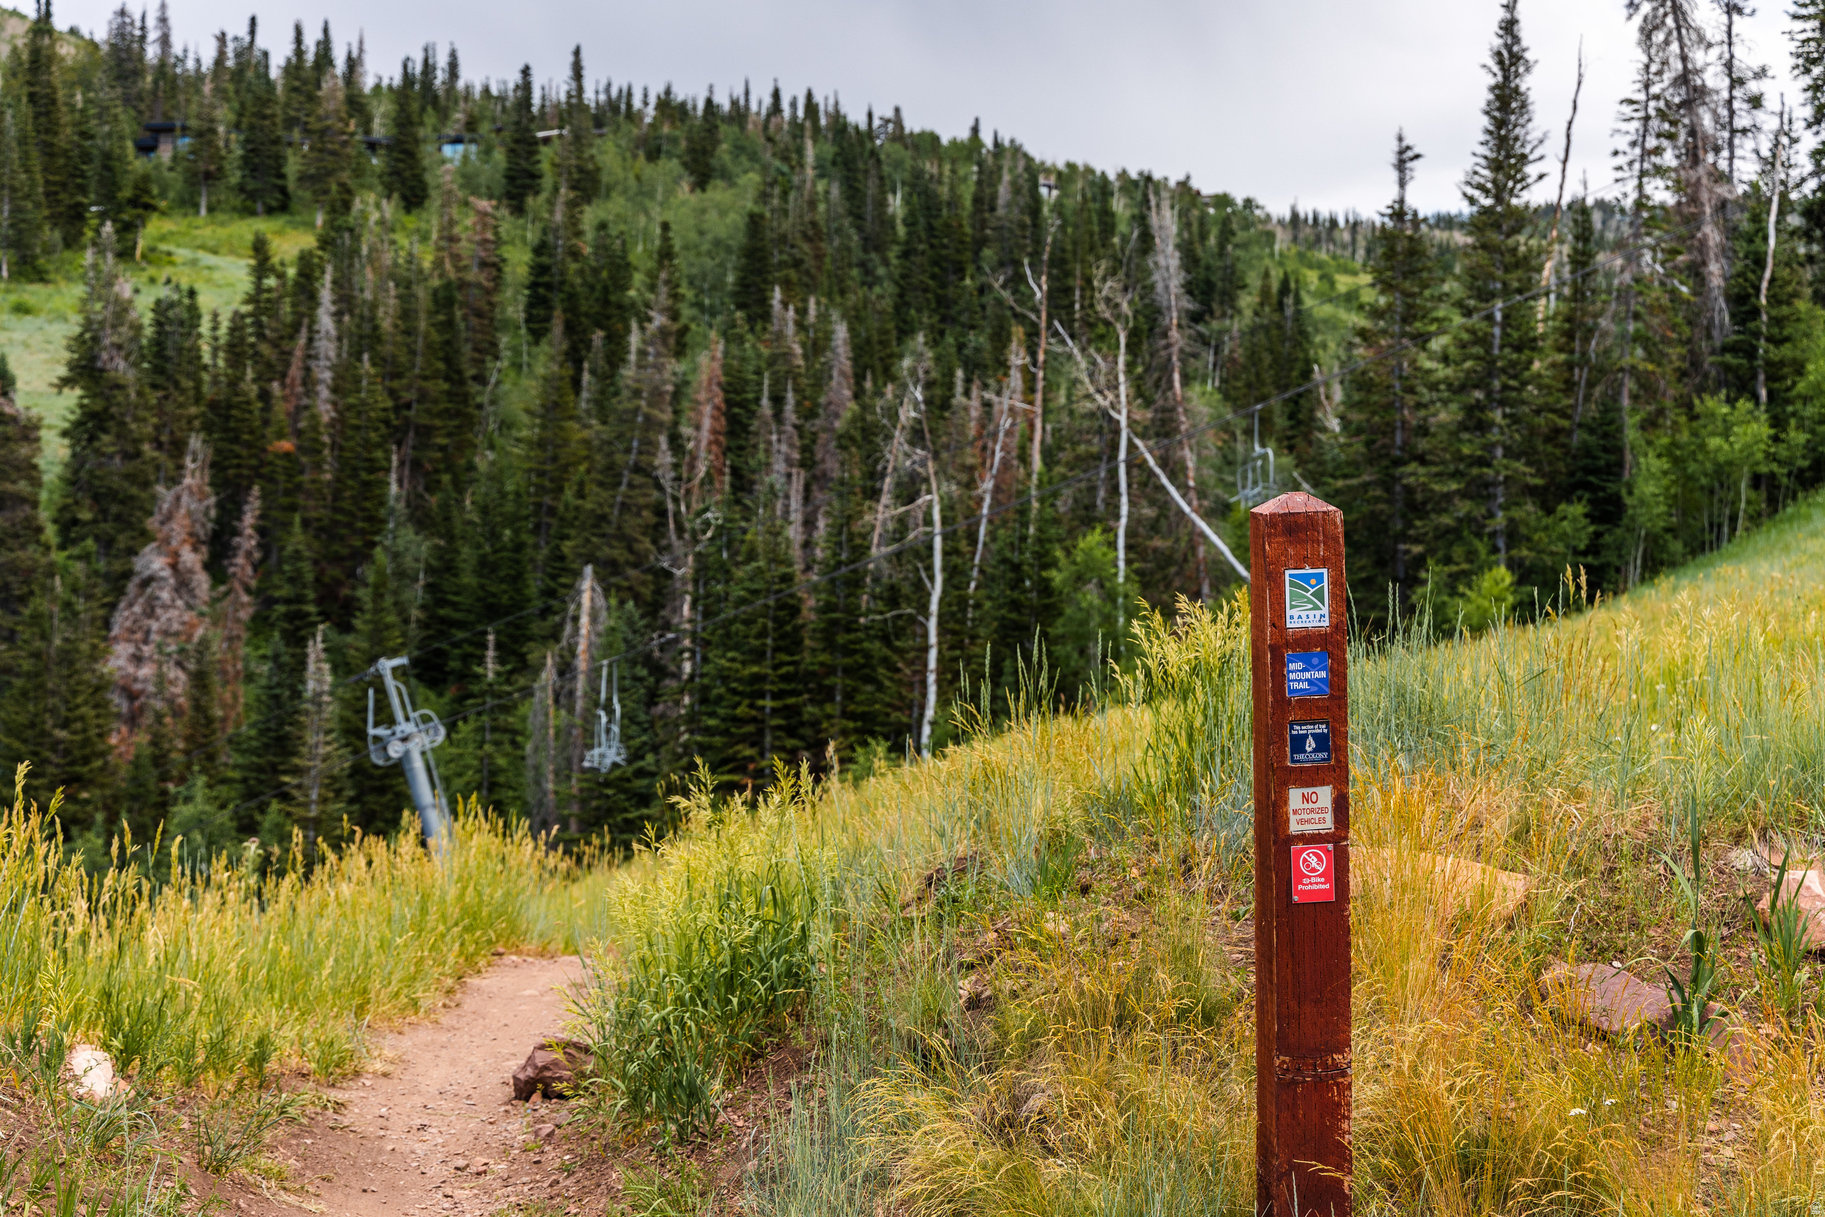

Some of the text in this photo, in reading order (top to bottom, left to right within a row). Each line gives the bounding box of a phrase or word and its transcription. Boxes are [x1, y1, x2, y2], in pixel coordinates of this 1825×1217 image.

[1289, 662, 1306, 670] MID-
[1289, 671, 1326, 680] MOUNTAIN
[1289, 681, 1310, 690] TRAIL
[1301, 791, 1319, 805] NO
[1292, 806, 1329, 816] MOTORIZED
[1295, 816, 1327, 825] VEHICLES
